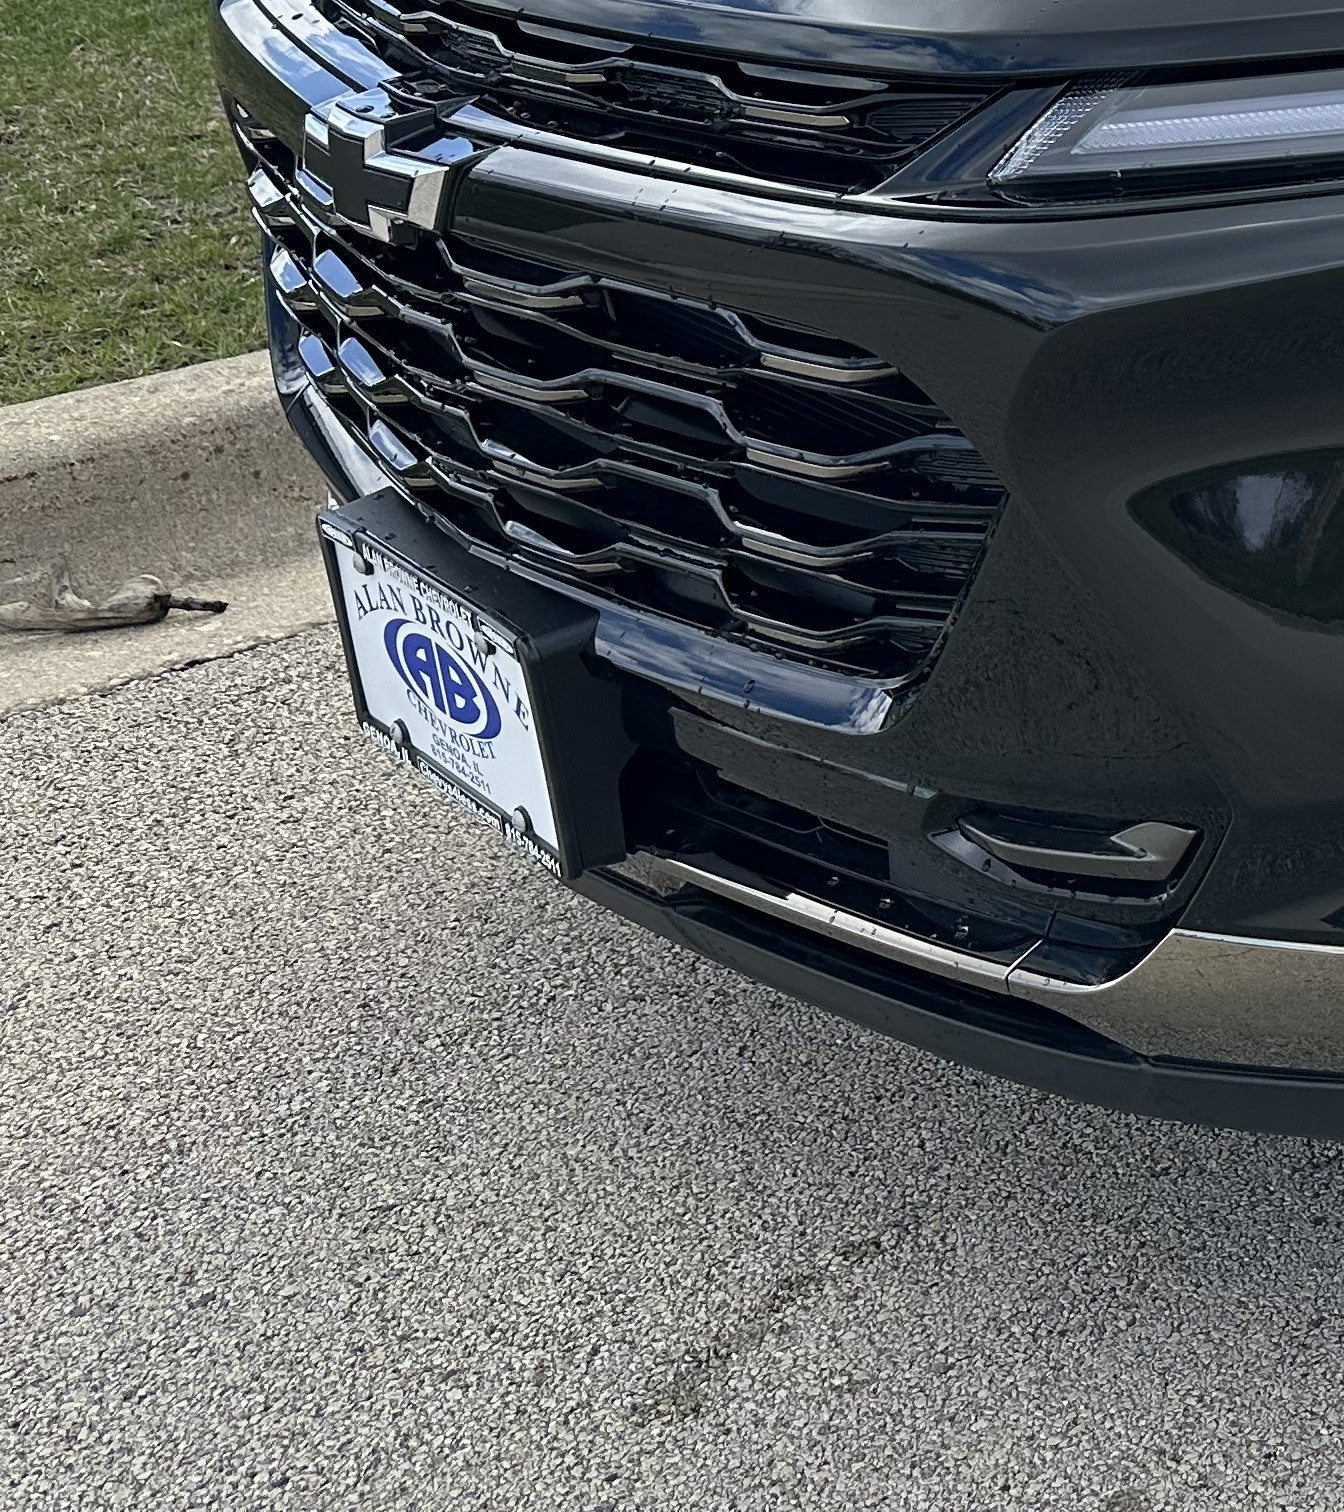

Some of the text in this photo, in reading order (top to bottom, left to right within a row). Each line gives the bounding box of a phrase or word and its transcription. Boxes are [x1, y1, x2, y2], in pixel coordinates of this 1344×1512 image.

[362, 542, 387, 572] ALAN
[354, 582, 529, 732] ALAN BROWNE
[406, 688, 496, 760] CHEVROLET
[430, 743, 491, 795] 815-784-2511
[504, 822, 562, 878] 815-784-2511
